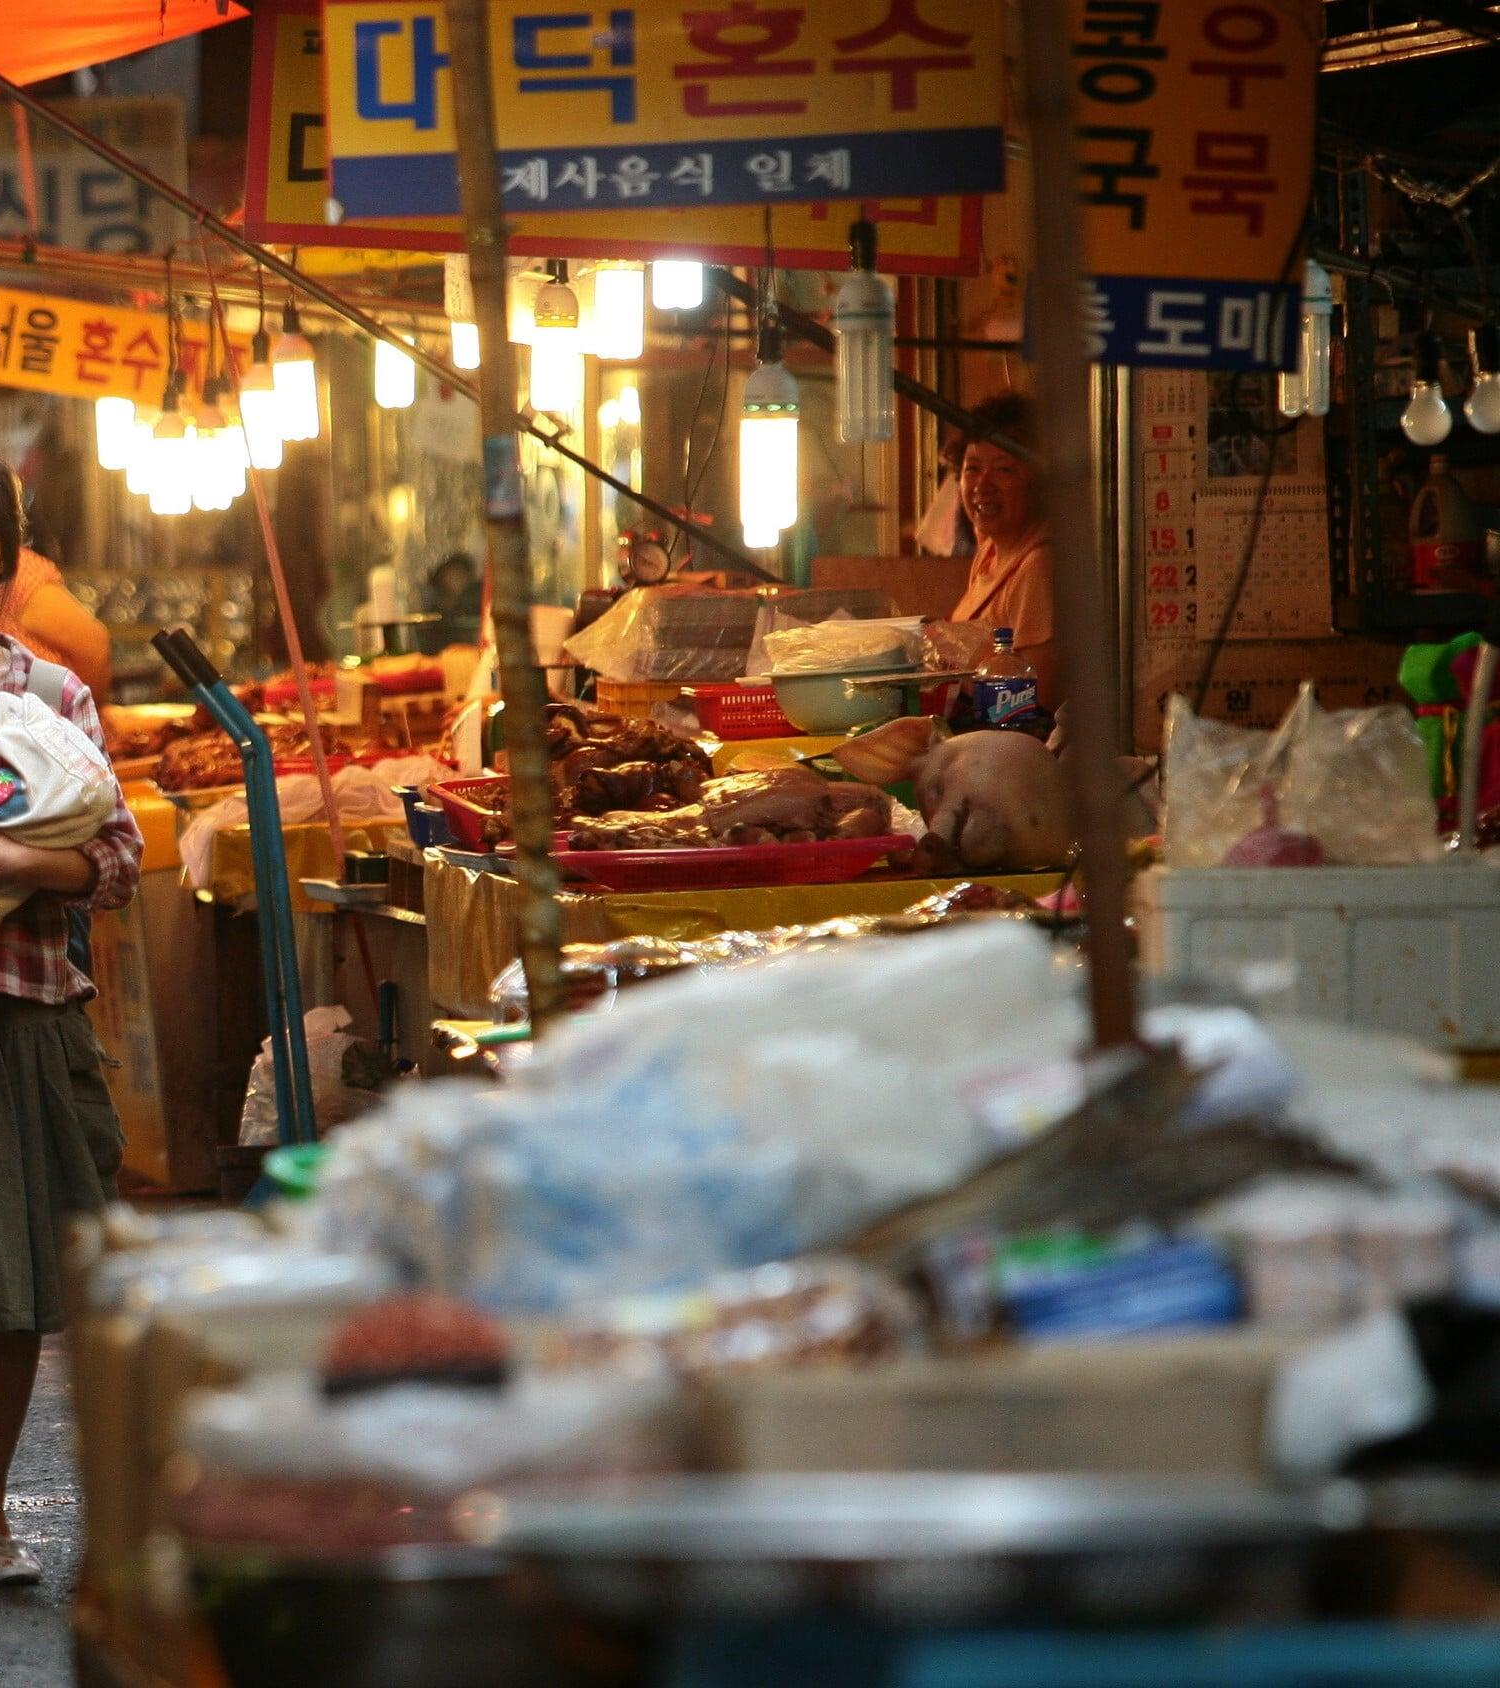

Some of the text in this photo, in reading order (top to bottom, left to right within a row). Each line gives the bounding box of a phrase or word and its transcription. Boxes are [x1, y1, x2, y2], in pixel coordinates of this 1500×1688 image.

[502, 148, 852, 200] 제사음식 일체
[76, 318, 160, 391] 혼수
[1150, 528, 1176, 549] 15
[1151, 566, 1178, 588] 22
[1151, 603, 1179, 624] 29
